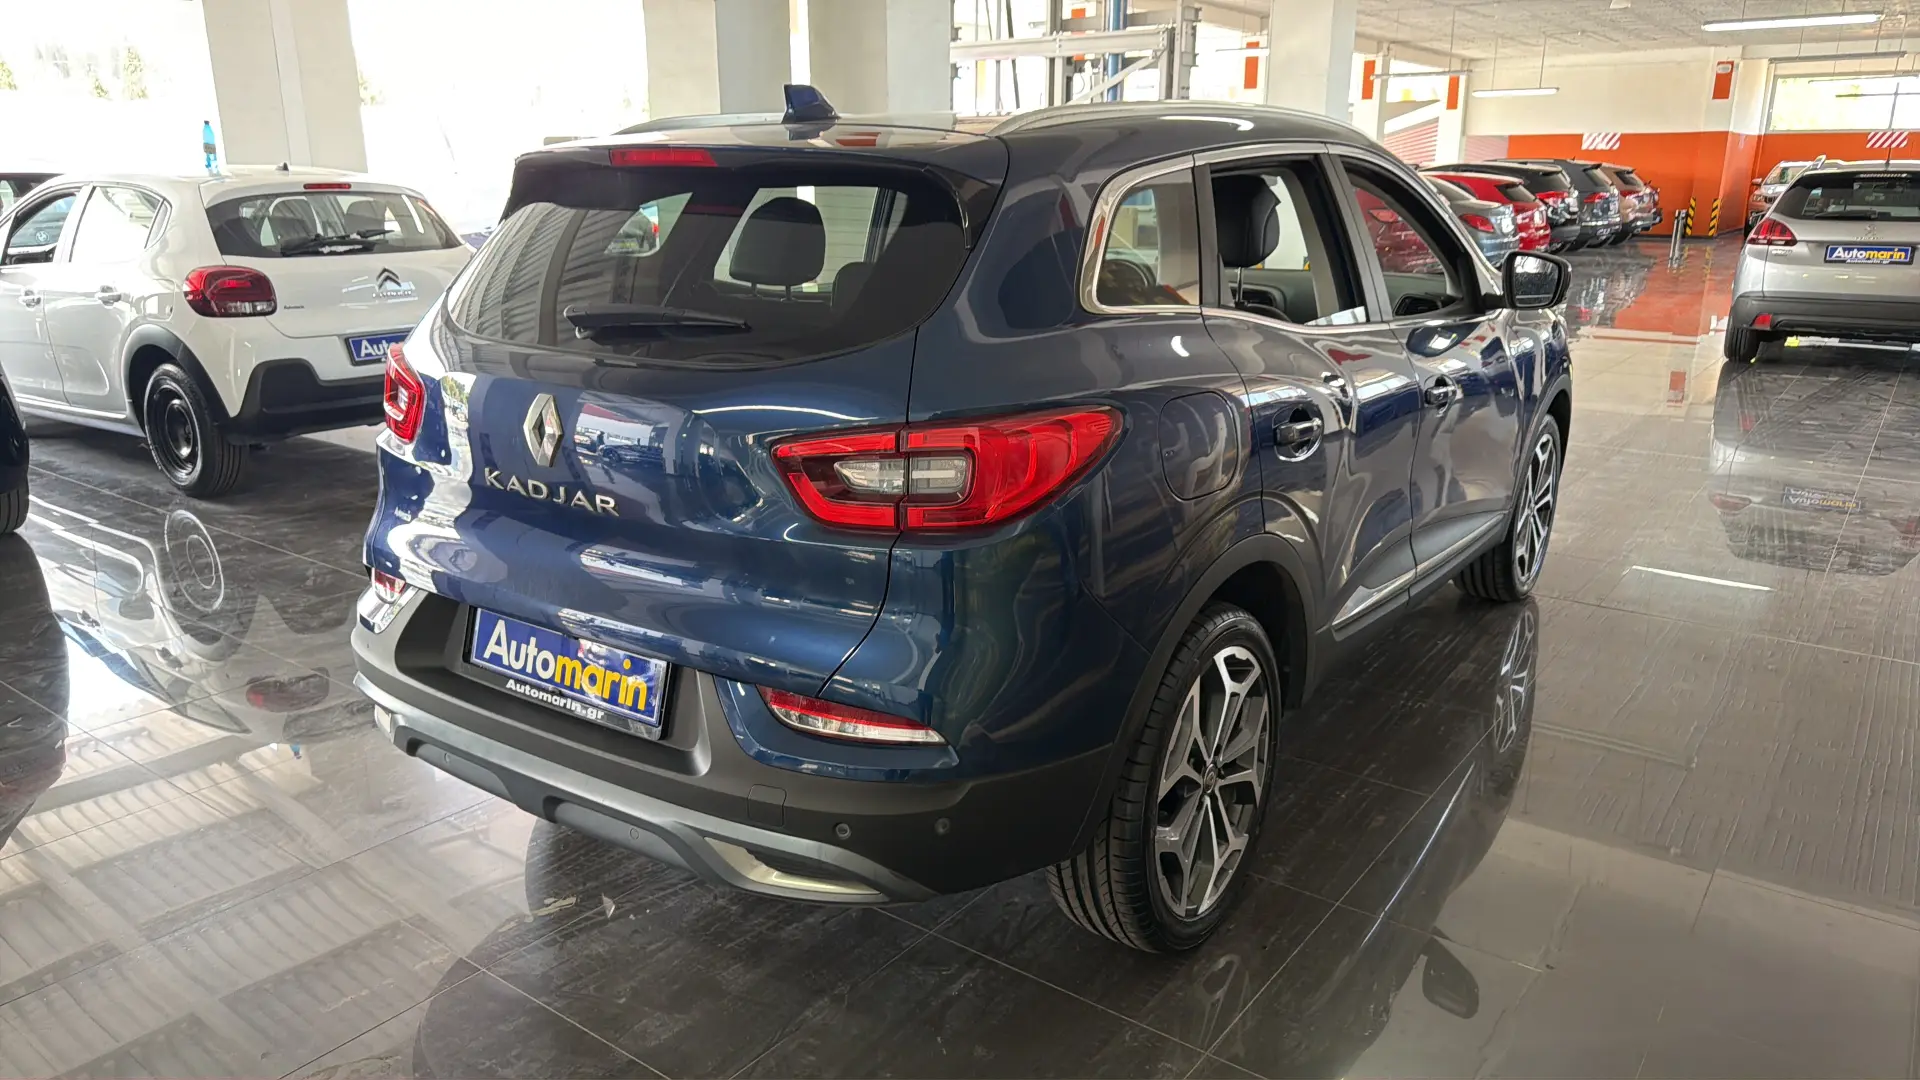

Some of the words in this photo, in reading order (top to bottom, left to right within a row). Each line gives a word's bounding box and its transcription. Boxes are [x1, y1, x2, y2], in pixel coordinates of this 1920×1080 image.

[1832, 247, 1906, 260] Automarin
[484, 467, 620, 517] KADJAR
[483, 619, 648, 711] Automarin
[505, 679, 605, 720] Automarin.gr
